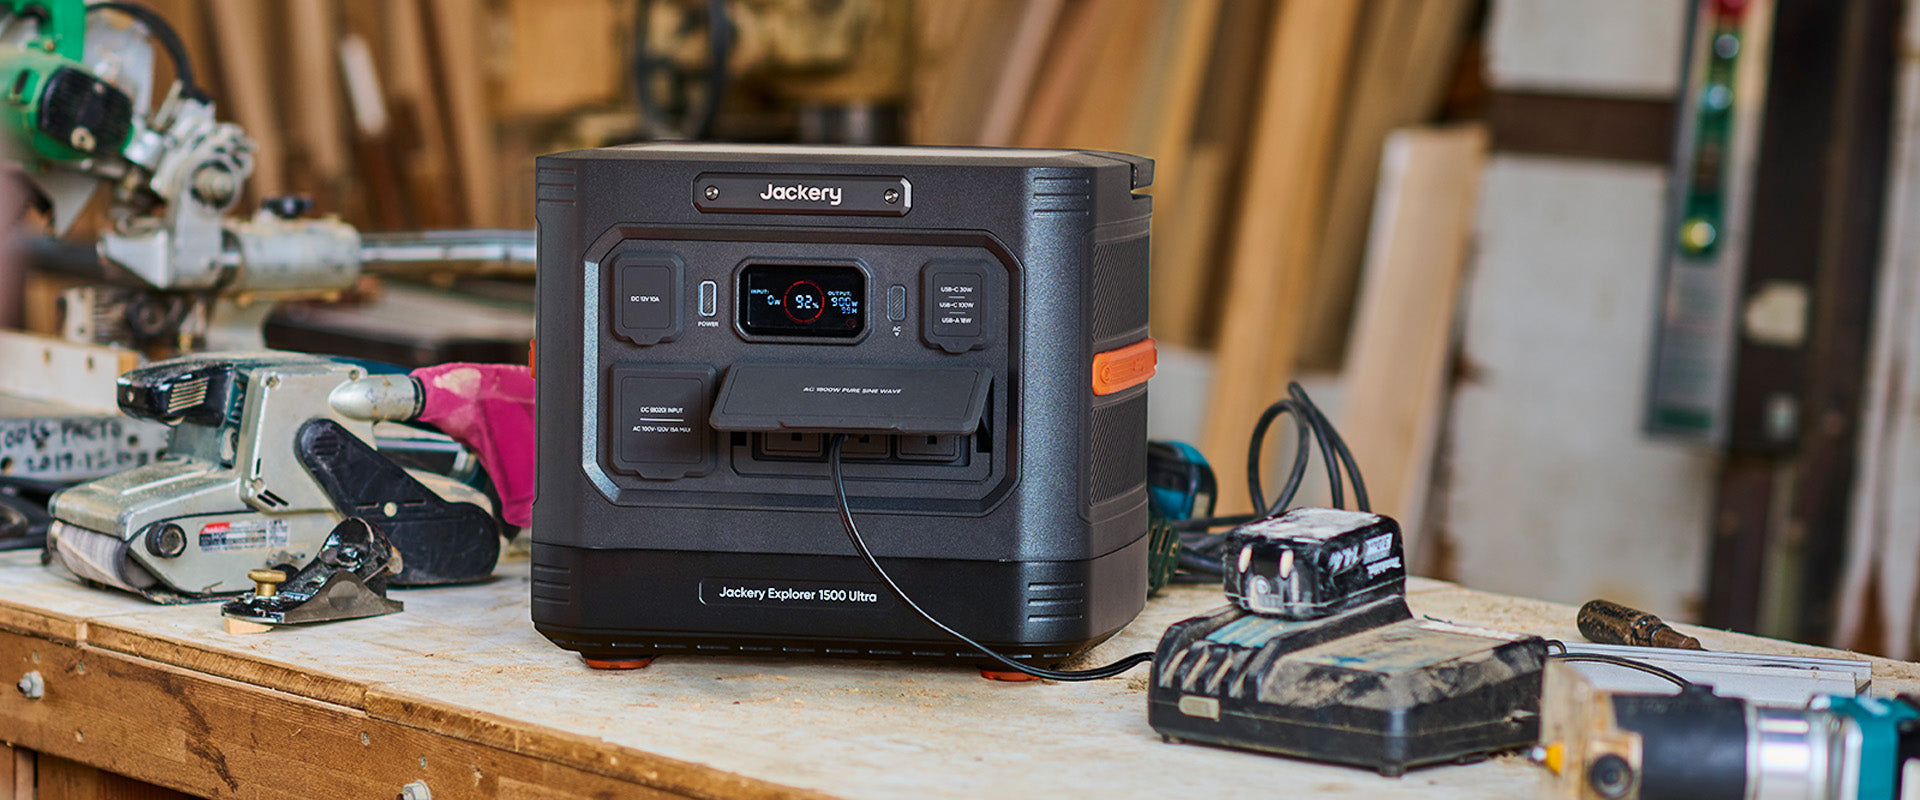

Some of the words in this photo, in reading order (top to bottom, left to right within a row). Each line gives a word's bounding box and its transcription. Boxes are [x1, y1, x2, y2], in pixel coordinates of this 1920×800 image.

[760, 184, 842, 206] Jackery
[719, 587, 766, 601] Jackery
[768, 588, 816, 602] Explorer
[819, 590, 846, 602] 1500
[849, 591, 877, 602] Ultra
